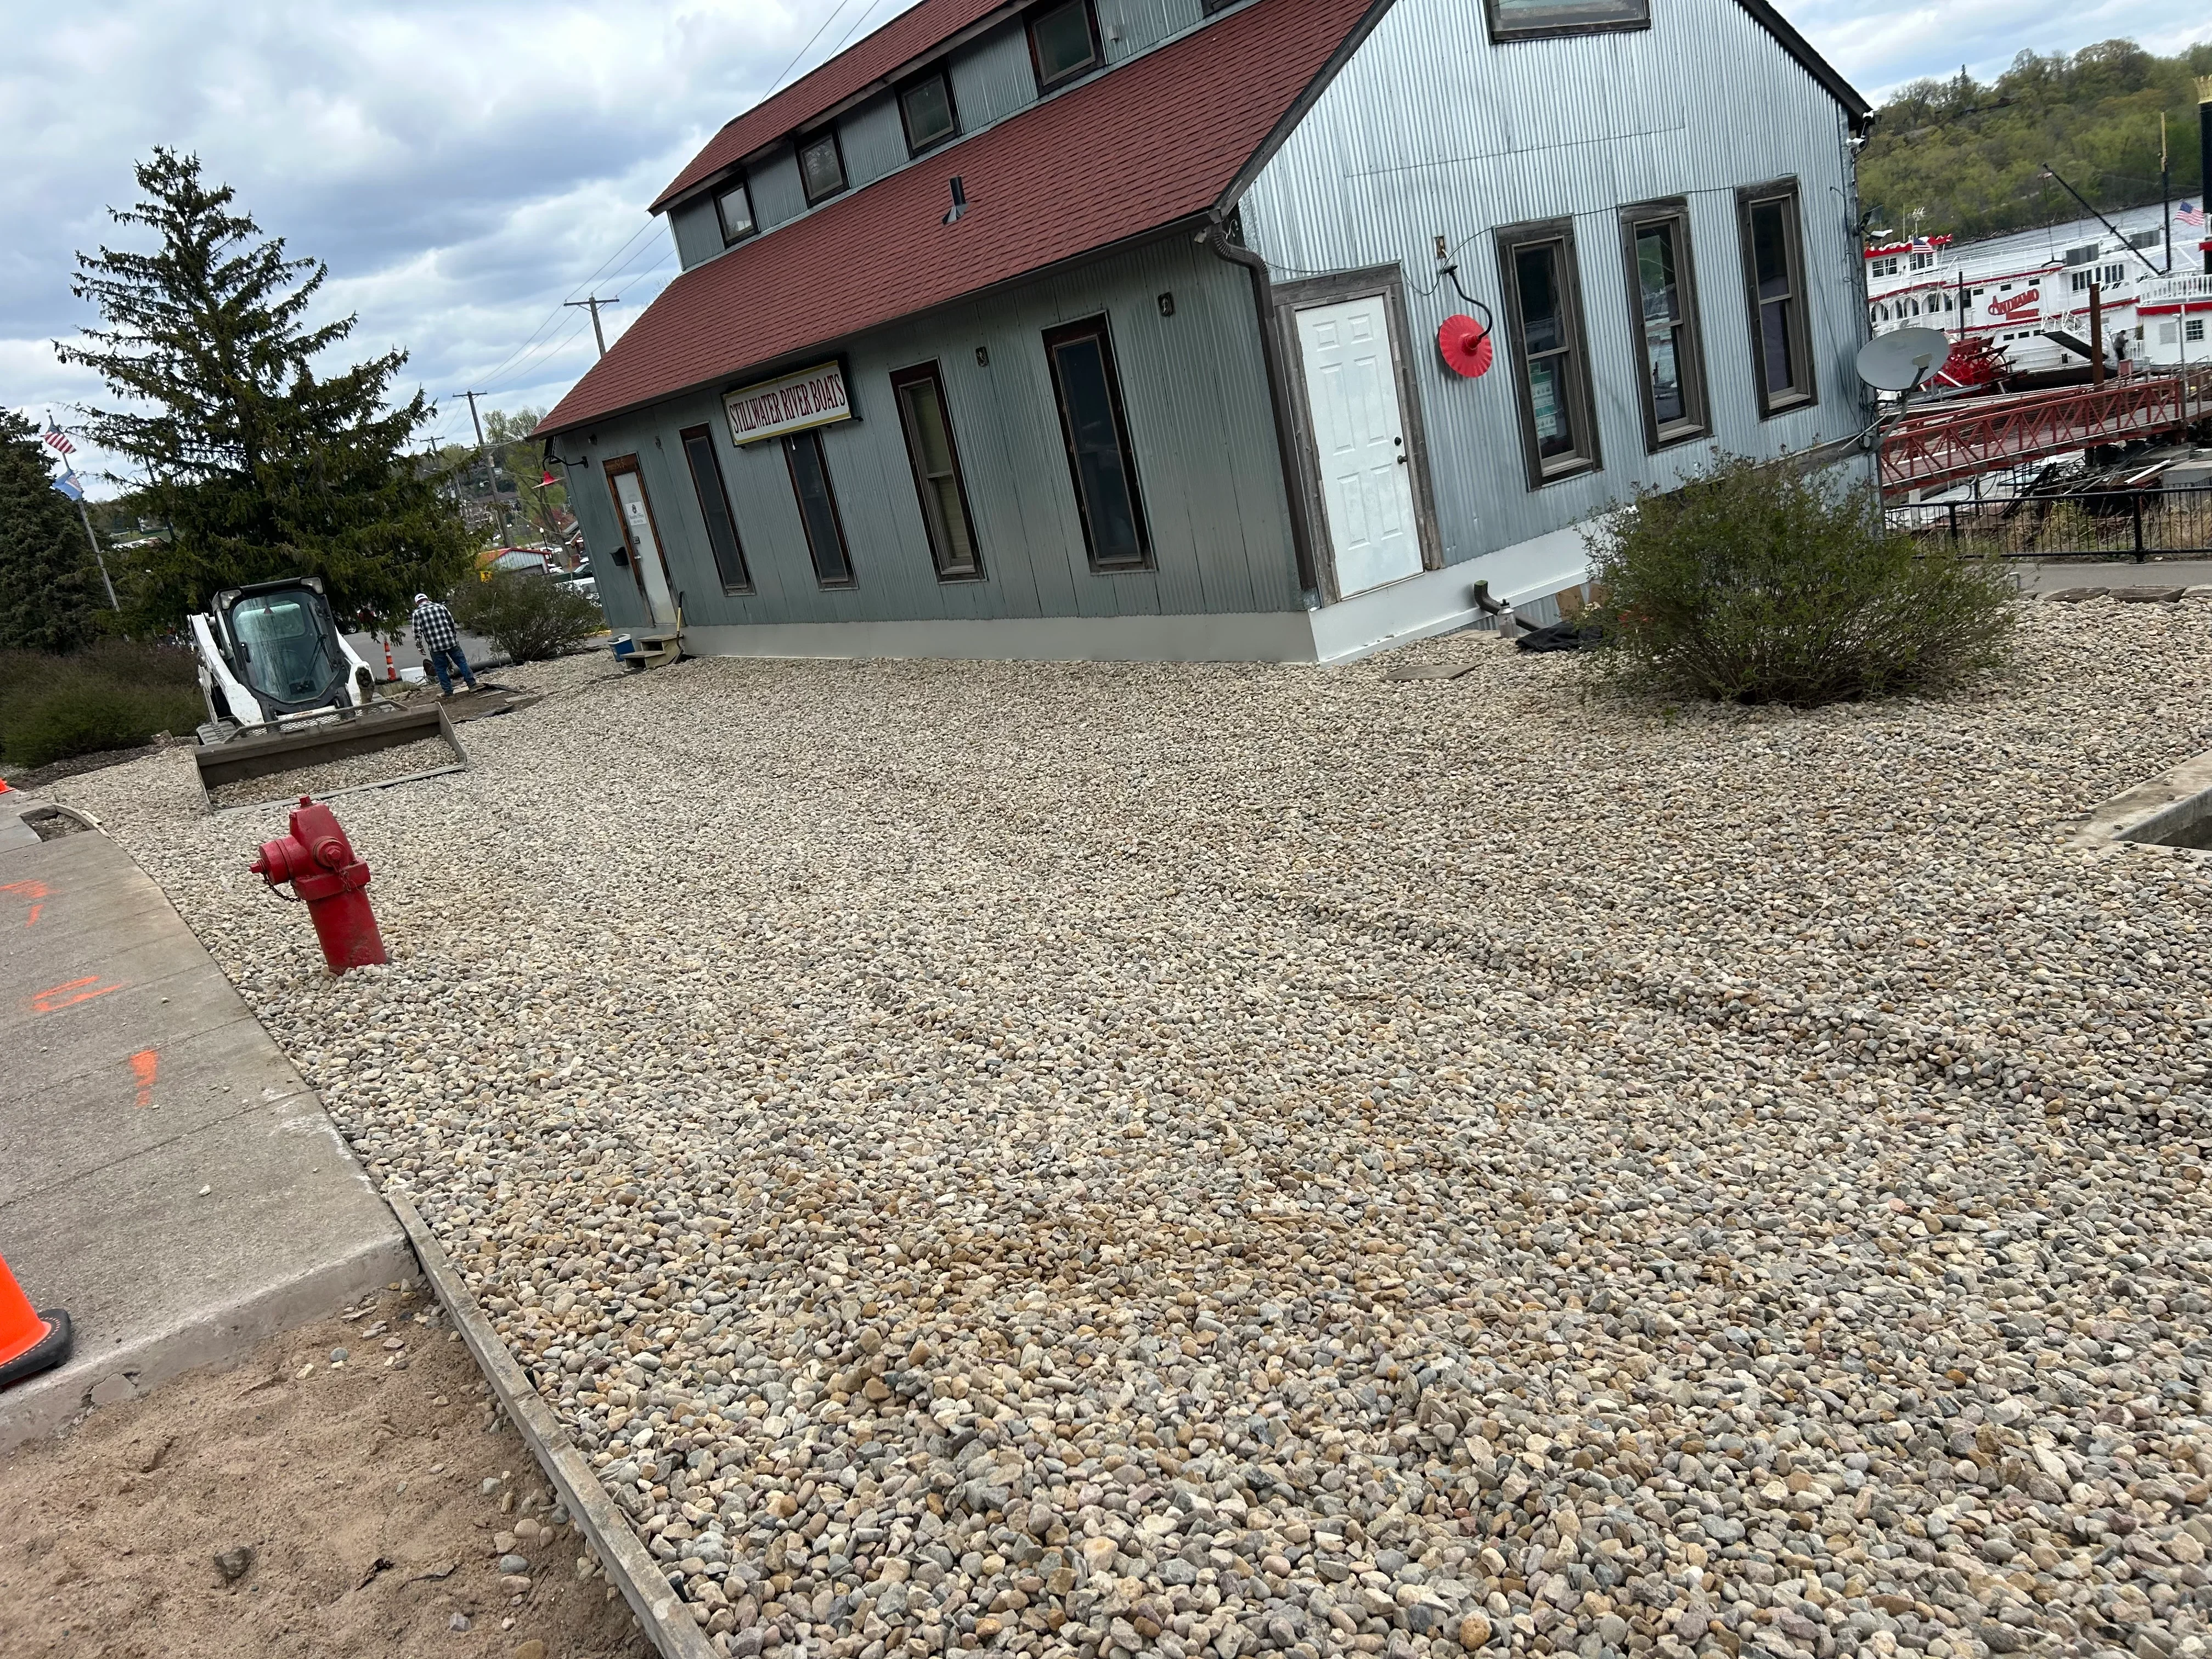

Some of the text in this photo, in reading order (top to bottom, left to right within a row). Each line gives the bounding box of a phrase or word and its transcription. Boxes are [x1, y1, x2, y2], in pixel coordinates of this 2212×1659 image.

[729, 373, 845, 433] STILLWATER RIVER BOATS
